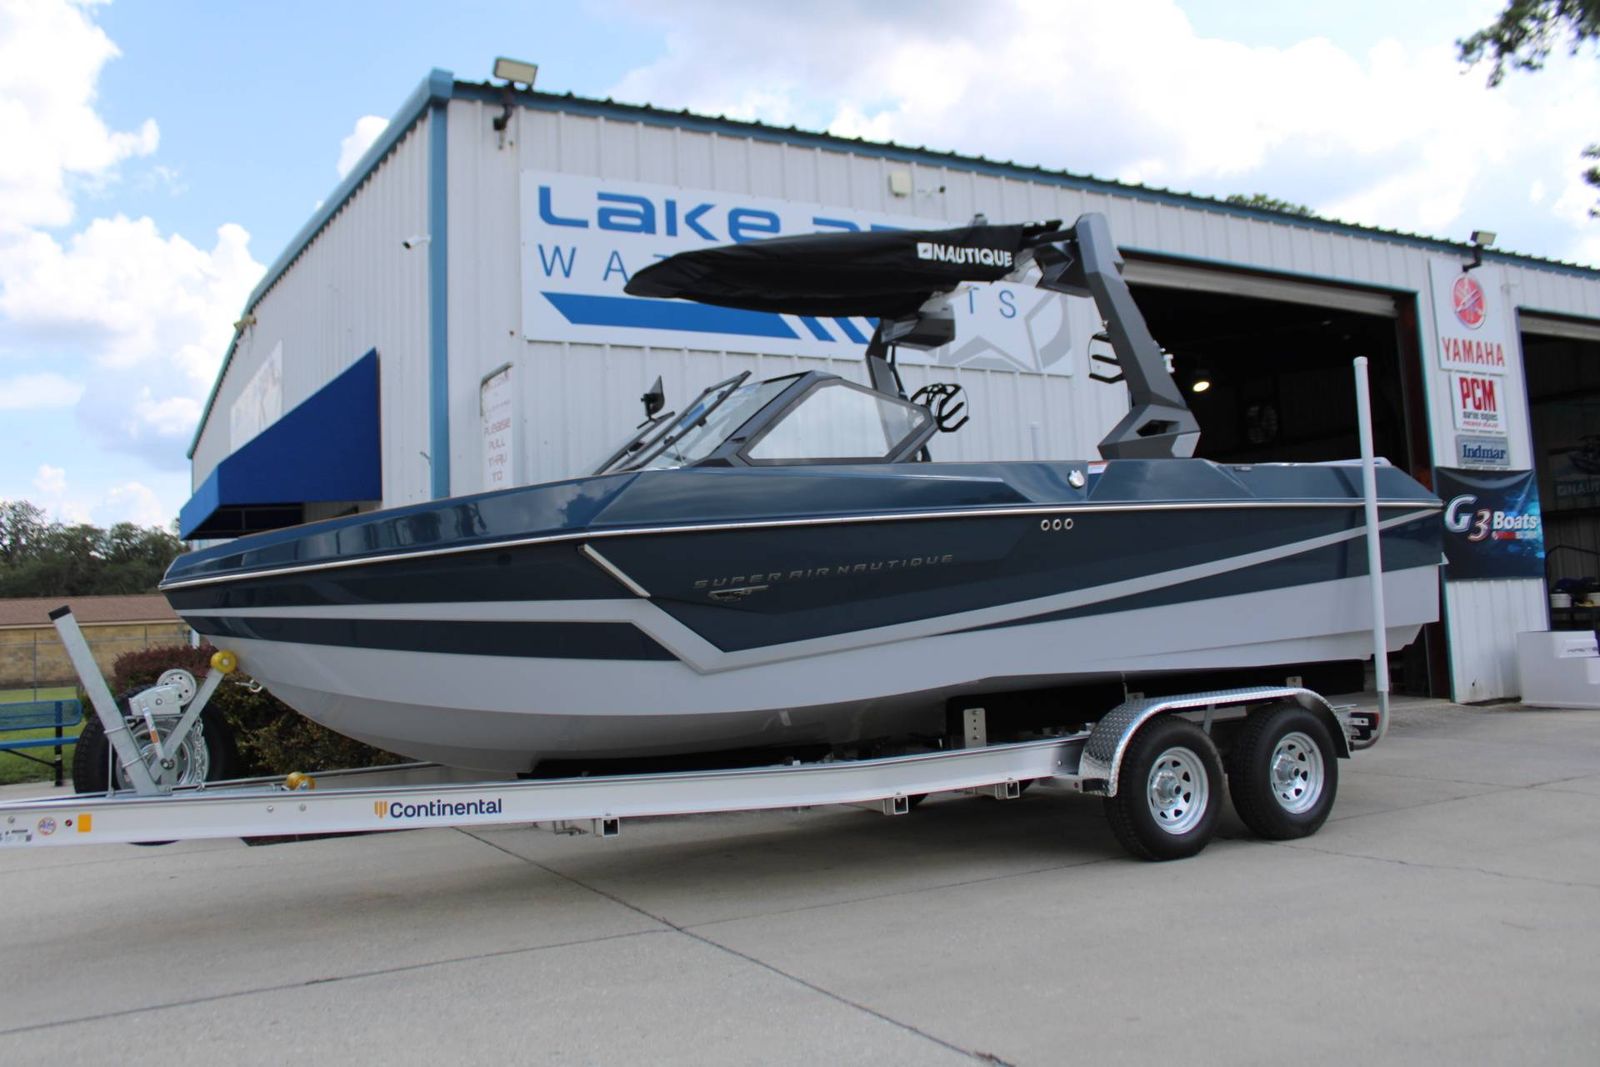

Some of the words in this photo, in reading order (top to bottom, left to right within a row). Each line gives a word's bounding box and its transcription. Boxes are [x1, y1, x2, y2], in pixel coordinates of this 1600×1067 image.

[538, 185, 781, 245] Lake
[933, 243, 1013, 267] NAUTIQUE
[1442, 336, 1505, 367] YAMAHA
[1459, 377, 1496, 412] PCM
[1463, 444, 1506, 460] Indmar
[1493, 511, 1538, 529] Boats
[694, 572, 782, 589] SUPER
[788, 566, 830, 579] AIR
[836, 553, 954, 575] NAUTIQUE
[390, 798, 502, 818] Continental
